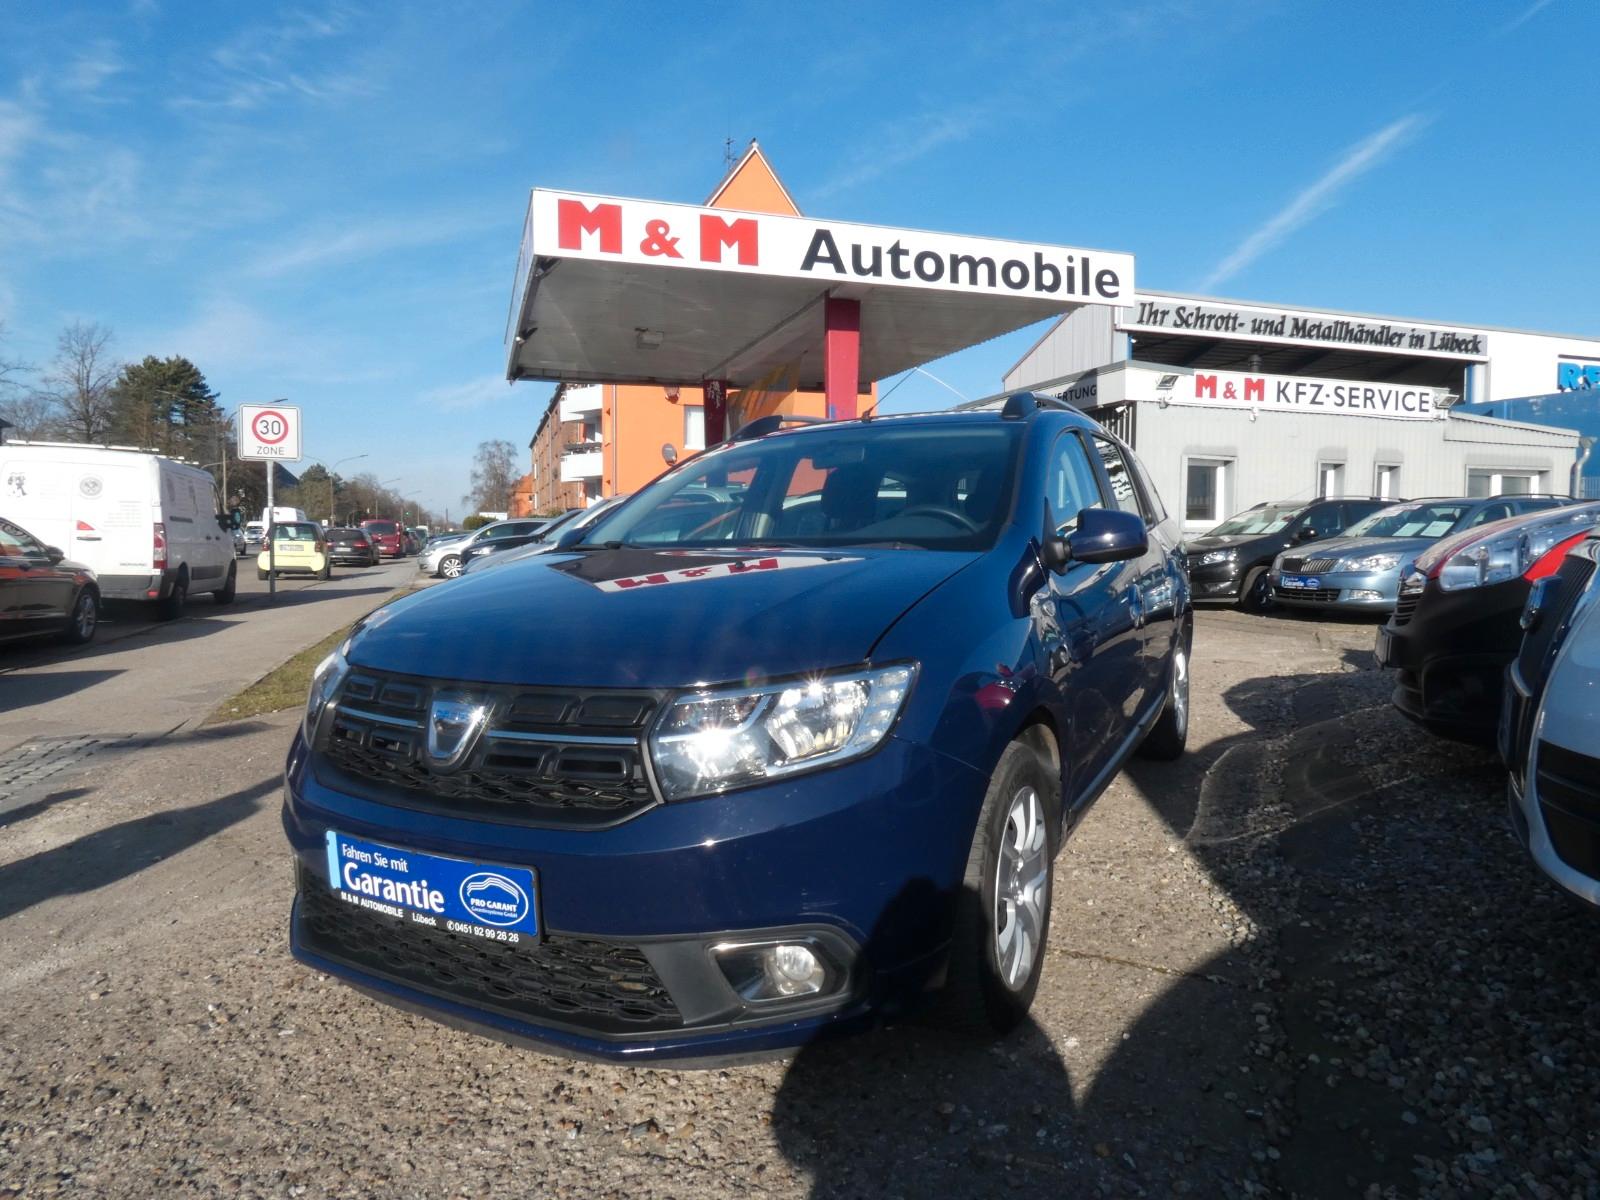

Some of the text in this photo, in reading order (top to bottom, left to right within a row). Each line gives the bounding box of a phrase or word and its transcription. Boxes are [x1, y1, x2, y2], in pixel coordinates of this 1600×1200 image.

[558, 199, 1119, 298] M & M Automobile
[1137, 302, 1482, 354] Ihr Schrott- und Metallhändler in Lübeck
[1195, 374, 1217, 399] M
[1223, 381, 1238, 400] &
[1244, 378, 1265, 401] M
[260, 420, 281, 435] 30
[256, 446, 285, 455] ZONE
[342, 843, 409, 873] Fahren Sie mit
[344, 862, 445, 913] Garantie
[340, 891, 347, 901] M
[353, 895, 359, 904] M
[361, 898, 404, 918] AUTOMOBILE
[412, 912, 437, 926] Lübeck
[470, 898, 518, 912] PRO GARANT
